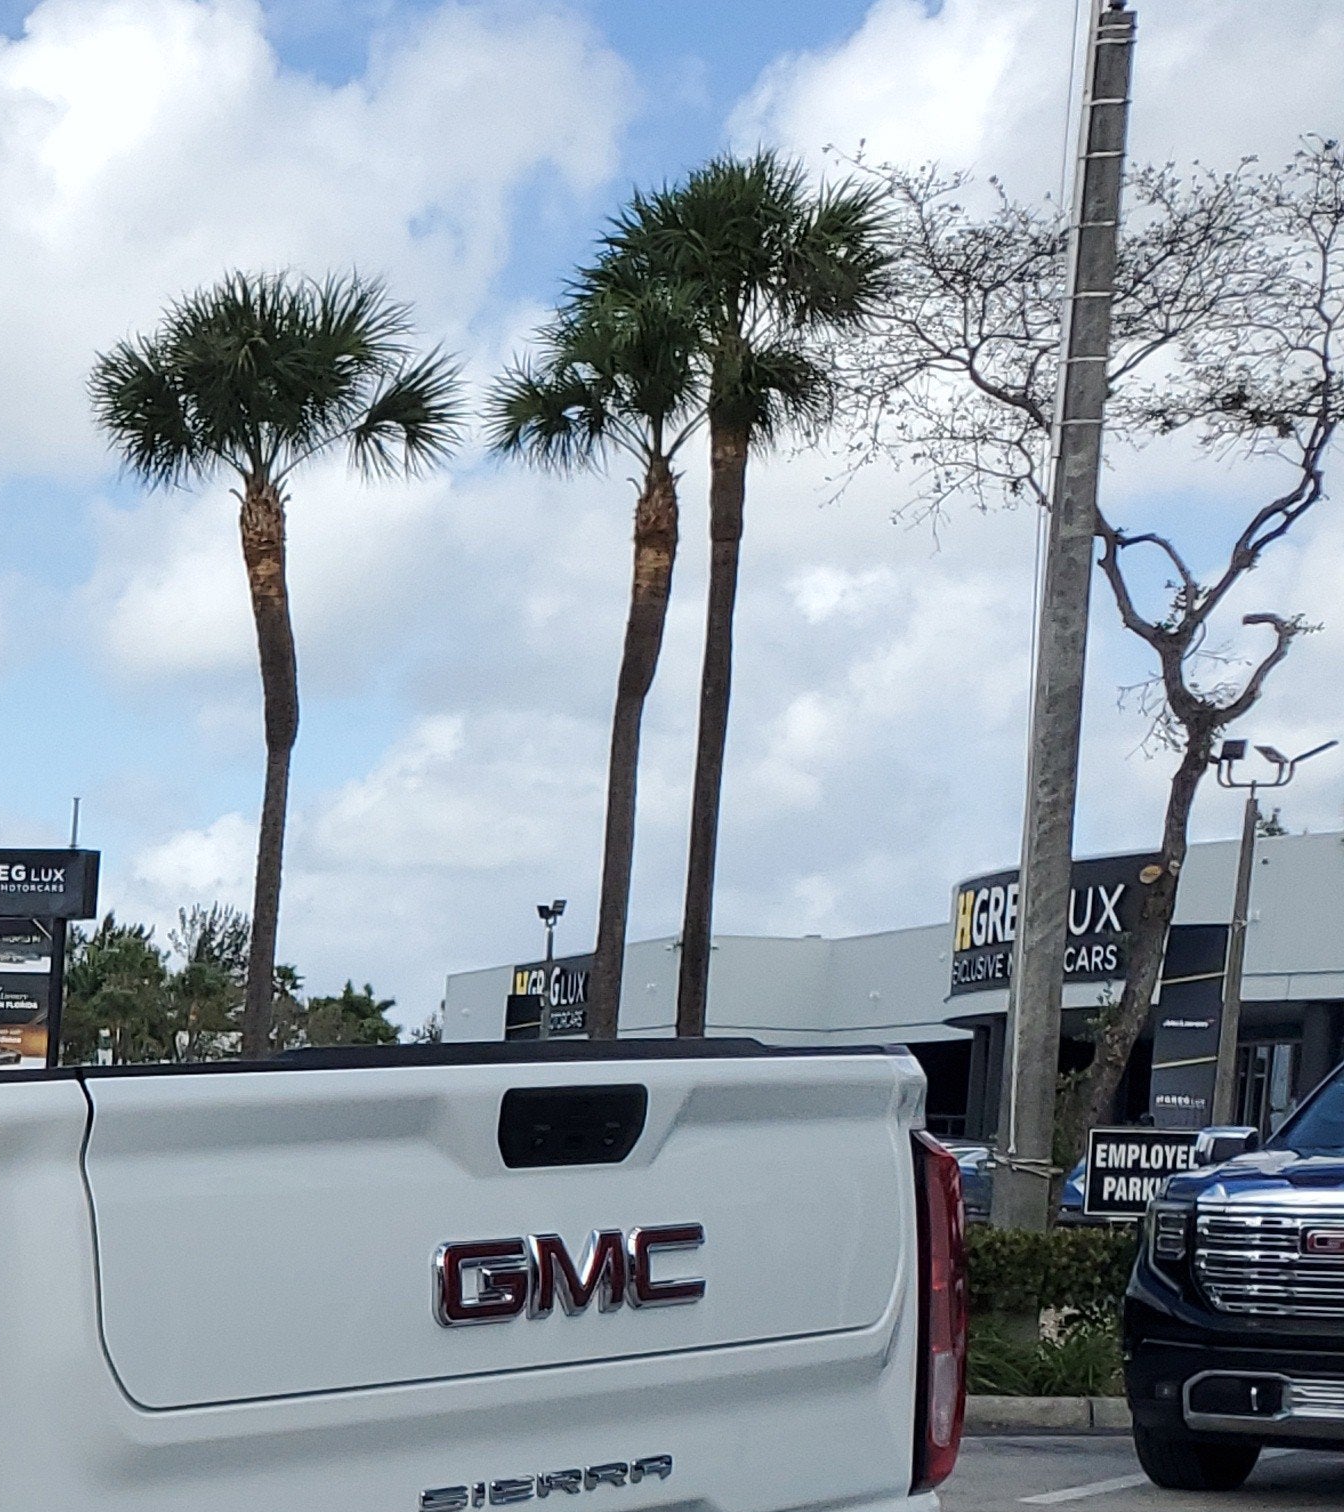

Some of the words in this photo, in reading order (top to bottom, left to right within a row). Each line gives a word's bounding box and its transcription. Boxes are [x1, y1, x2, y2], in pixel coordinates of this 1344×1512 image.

[0, 882, 65, 893] MOTORCARS
[30, 868, 66, 883] LUX
[954, 883, 1020, 952] HGRE
[1067, 883, 1126, 937] UX
[952, 952, 1006, 985] EXCLUSIVE
[515, 966, 561, 1007] HGRG
[560, 970, 586, 1005] LUX
[5, 1001, 38, 1010] FLORIDA
[431, 1221, 707, 1329] GMC
